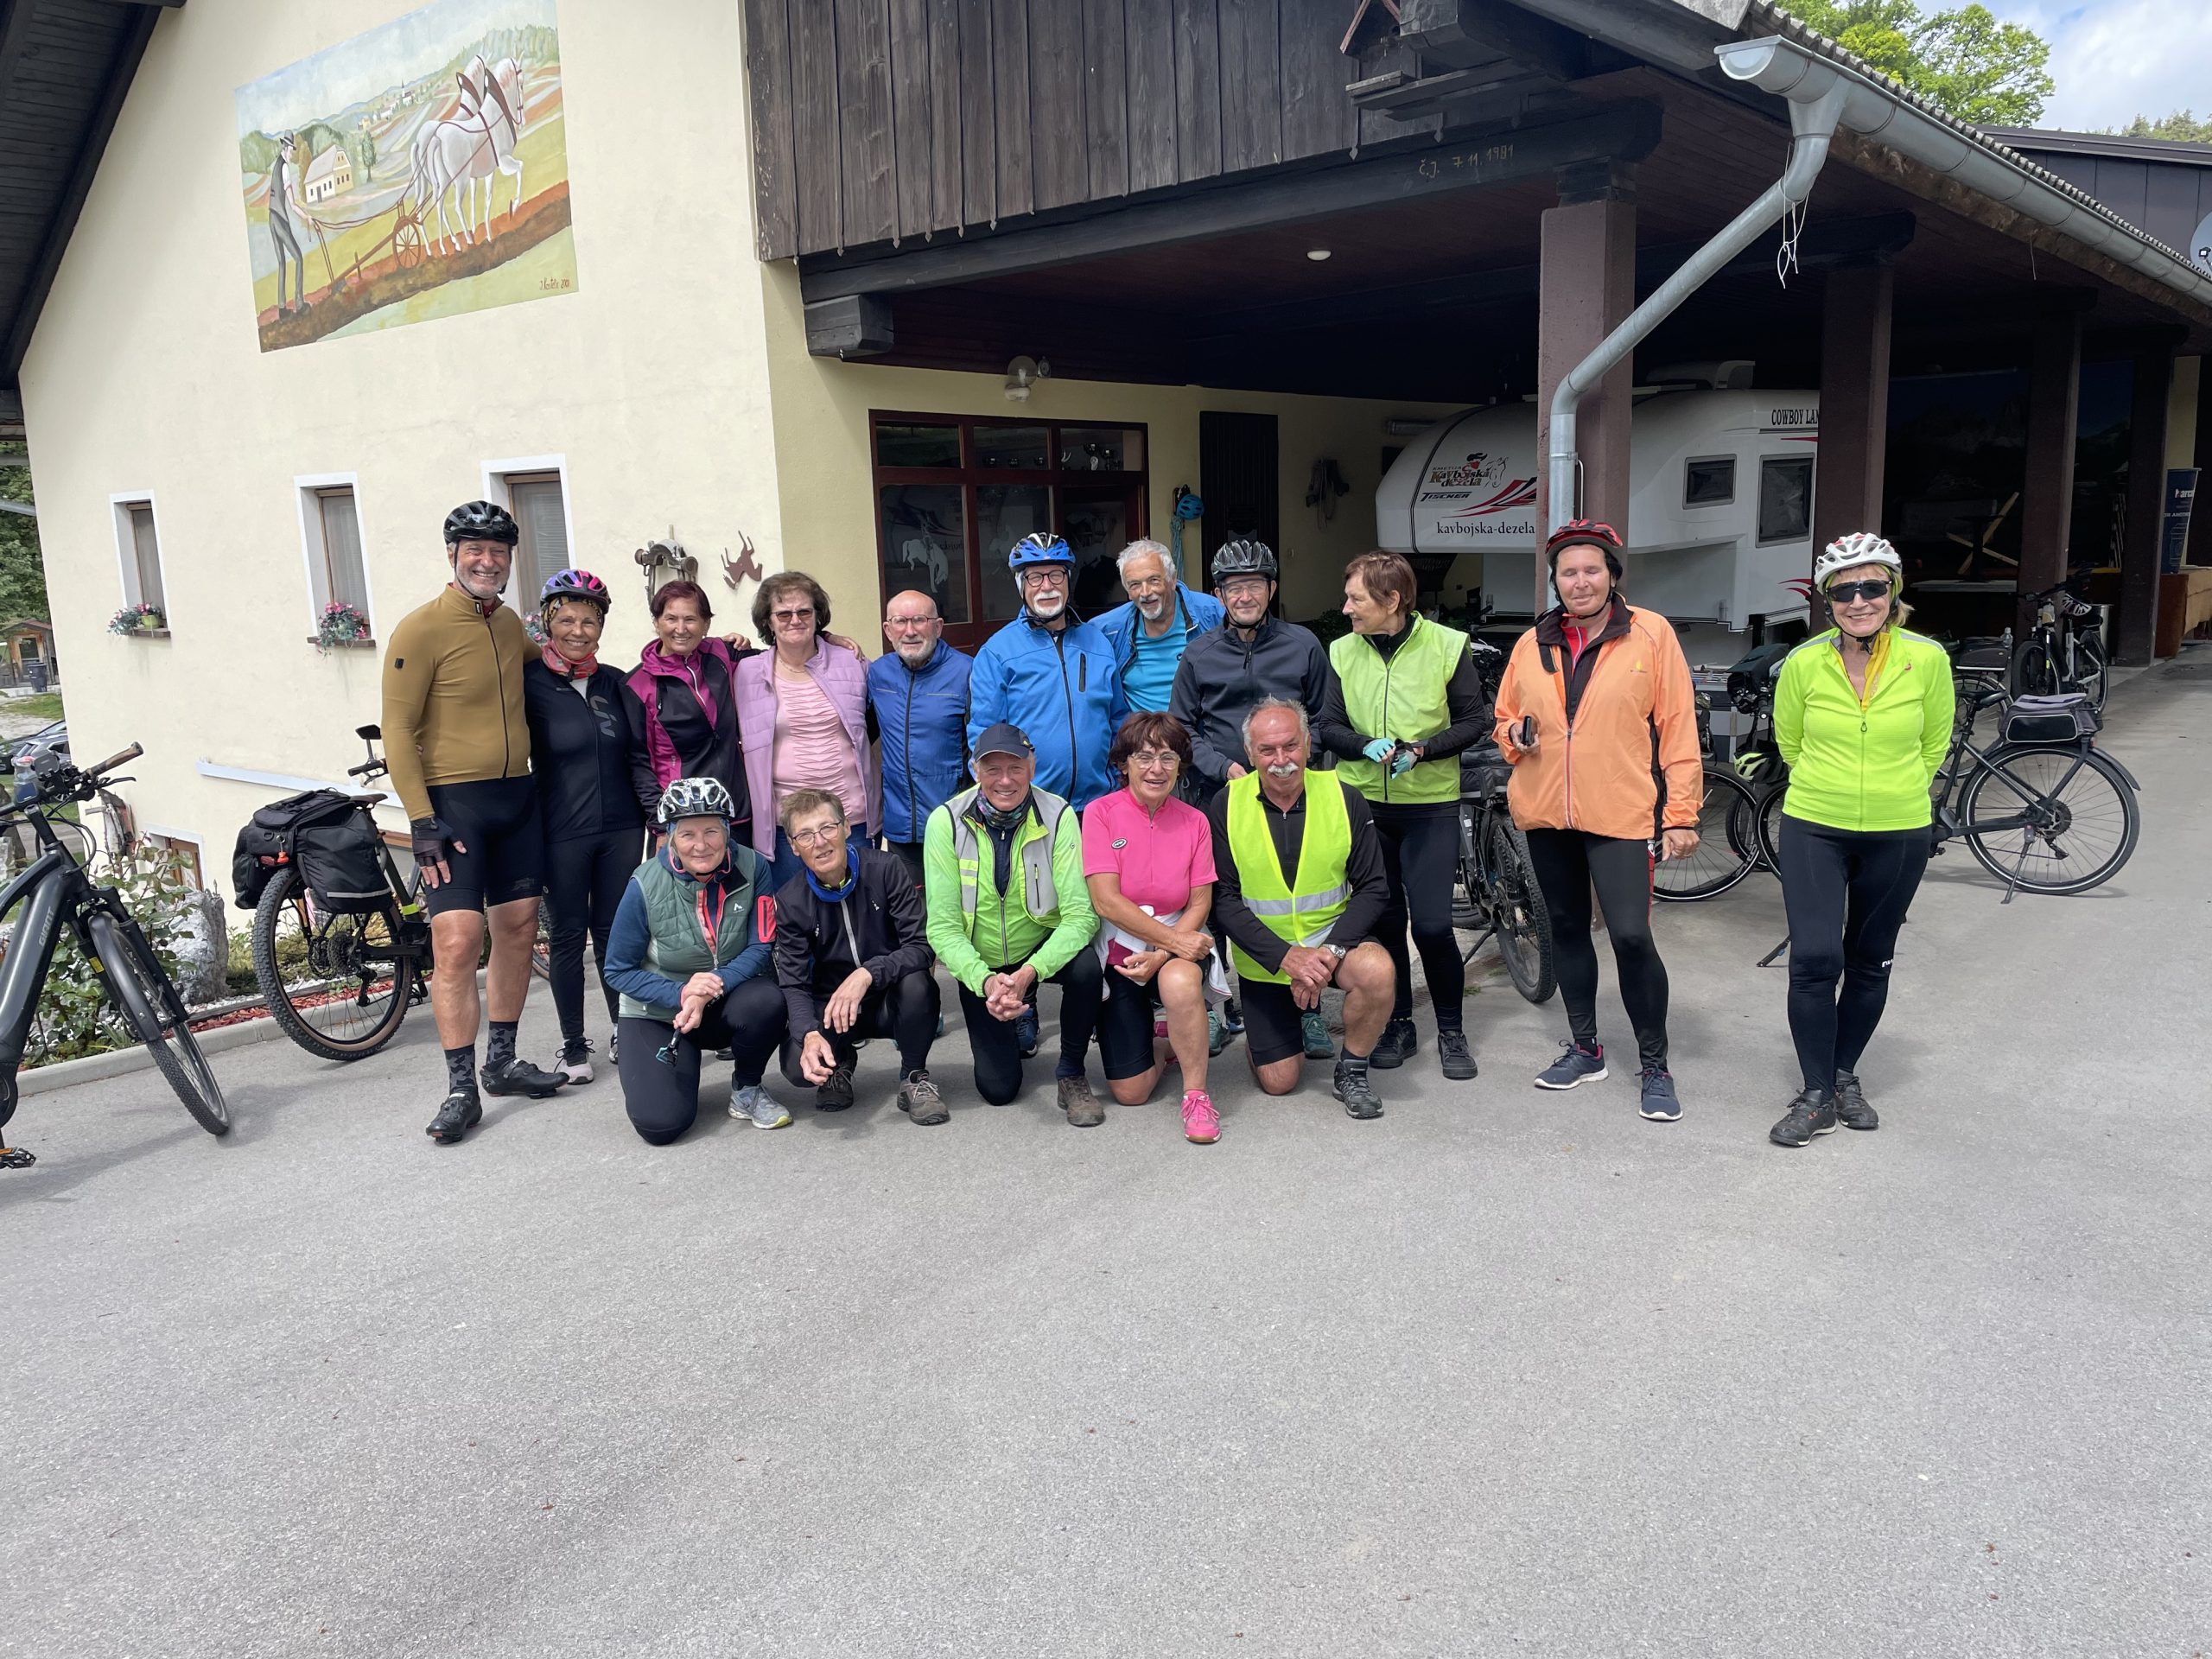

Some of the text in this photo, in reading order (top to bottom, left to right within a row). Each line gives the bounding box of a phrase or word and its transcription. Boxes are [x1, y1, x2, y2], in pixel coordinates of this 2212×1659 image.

[1771, 409, 1804, 426] COWBOY
[1436, 521, 1535, 537] kavbojska-dezela
[38, 905, 54, 947] GIANT
